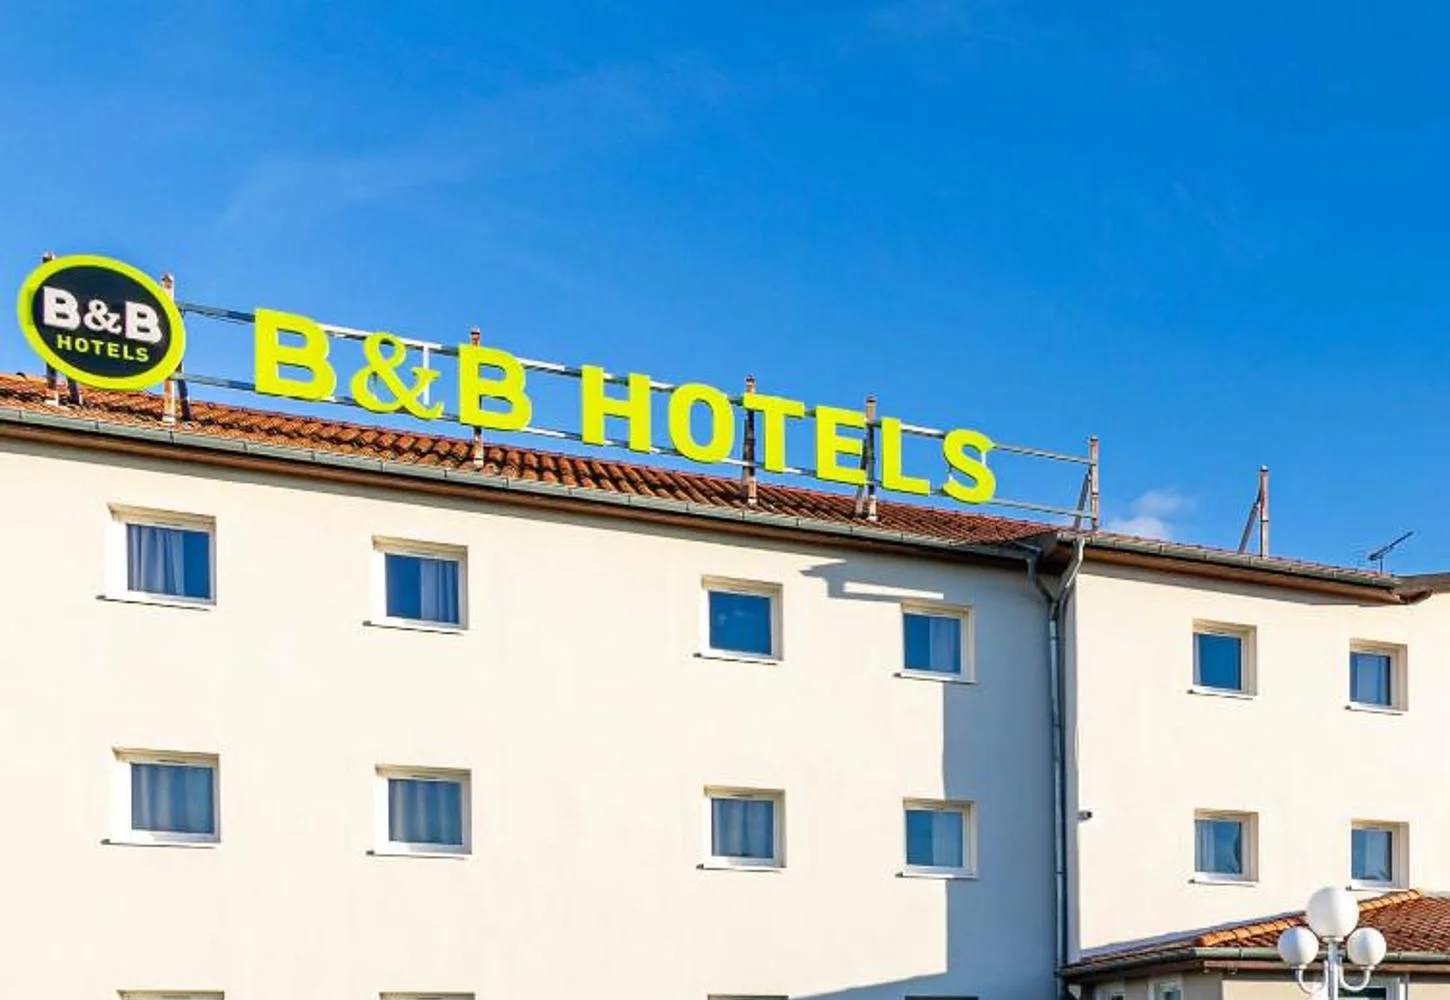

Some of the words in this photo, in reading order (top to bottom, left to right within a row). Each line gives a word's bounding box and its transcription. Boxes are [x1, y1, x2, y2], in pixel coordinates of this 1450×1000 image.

[43, 286, 163, 344] B&B
[56, 334, 149, 363] HOTELS
[253, 308, 534, 433] B&B
[580, 365, 998, 505] HOTELS
